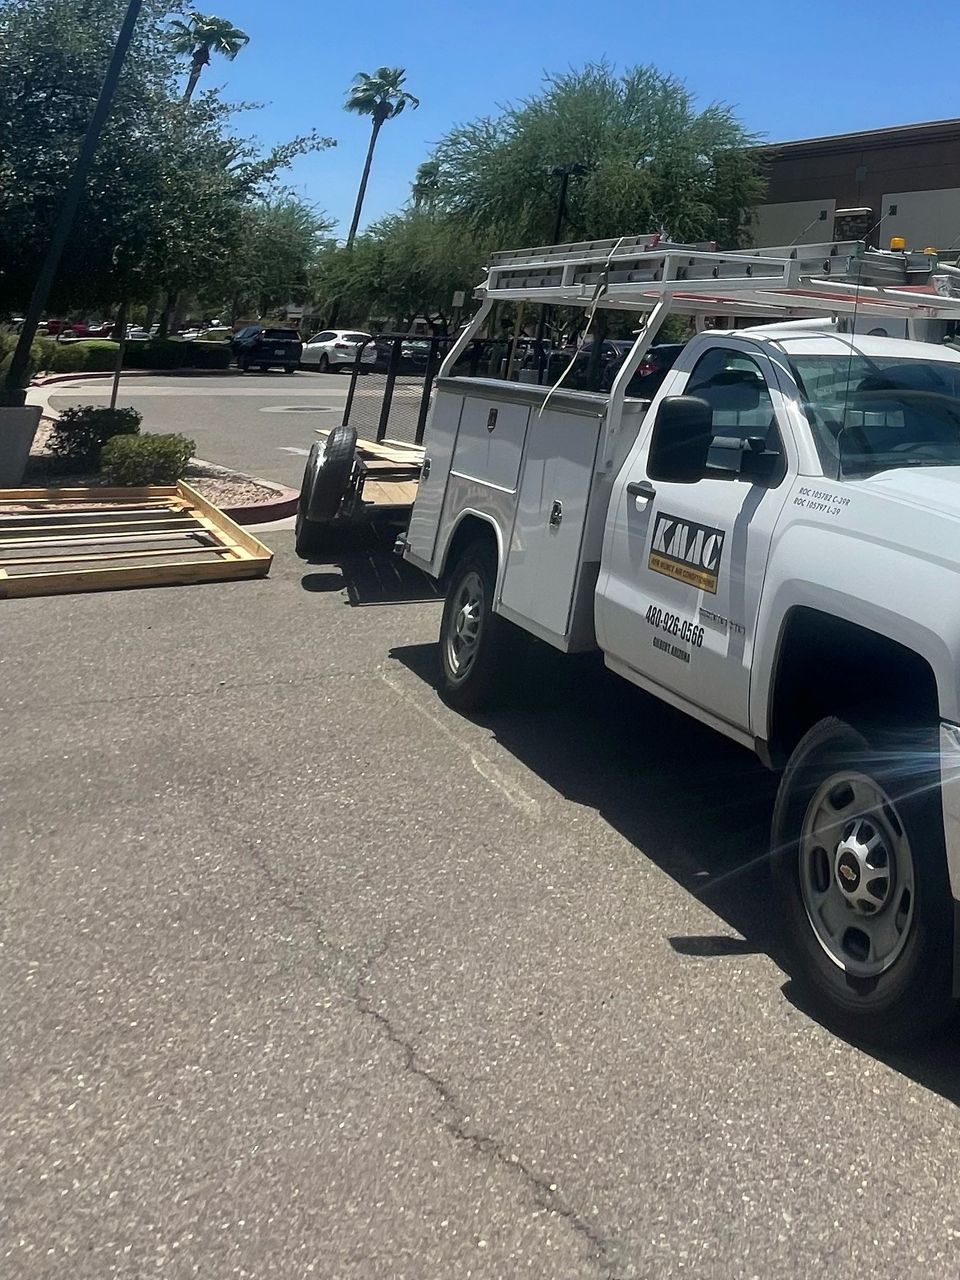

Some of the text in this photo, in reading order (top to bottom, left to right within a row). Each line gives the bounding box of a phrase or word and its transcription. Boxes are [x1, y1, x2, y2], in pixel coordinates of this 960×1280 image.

[793, 497, 806, 507] ROC
[799, 487, 811, 496] ROC
[652, 517, 723, 570] KMAC
[645, 604, 705, 648] 480-926-0566
